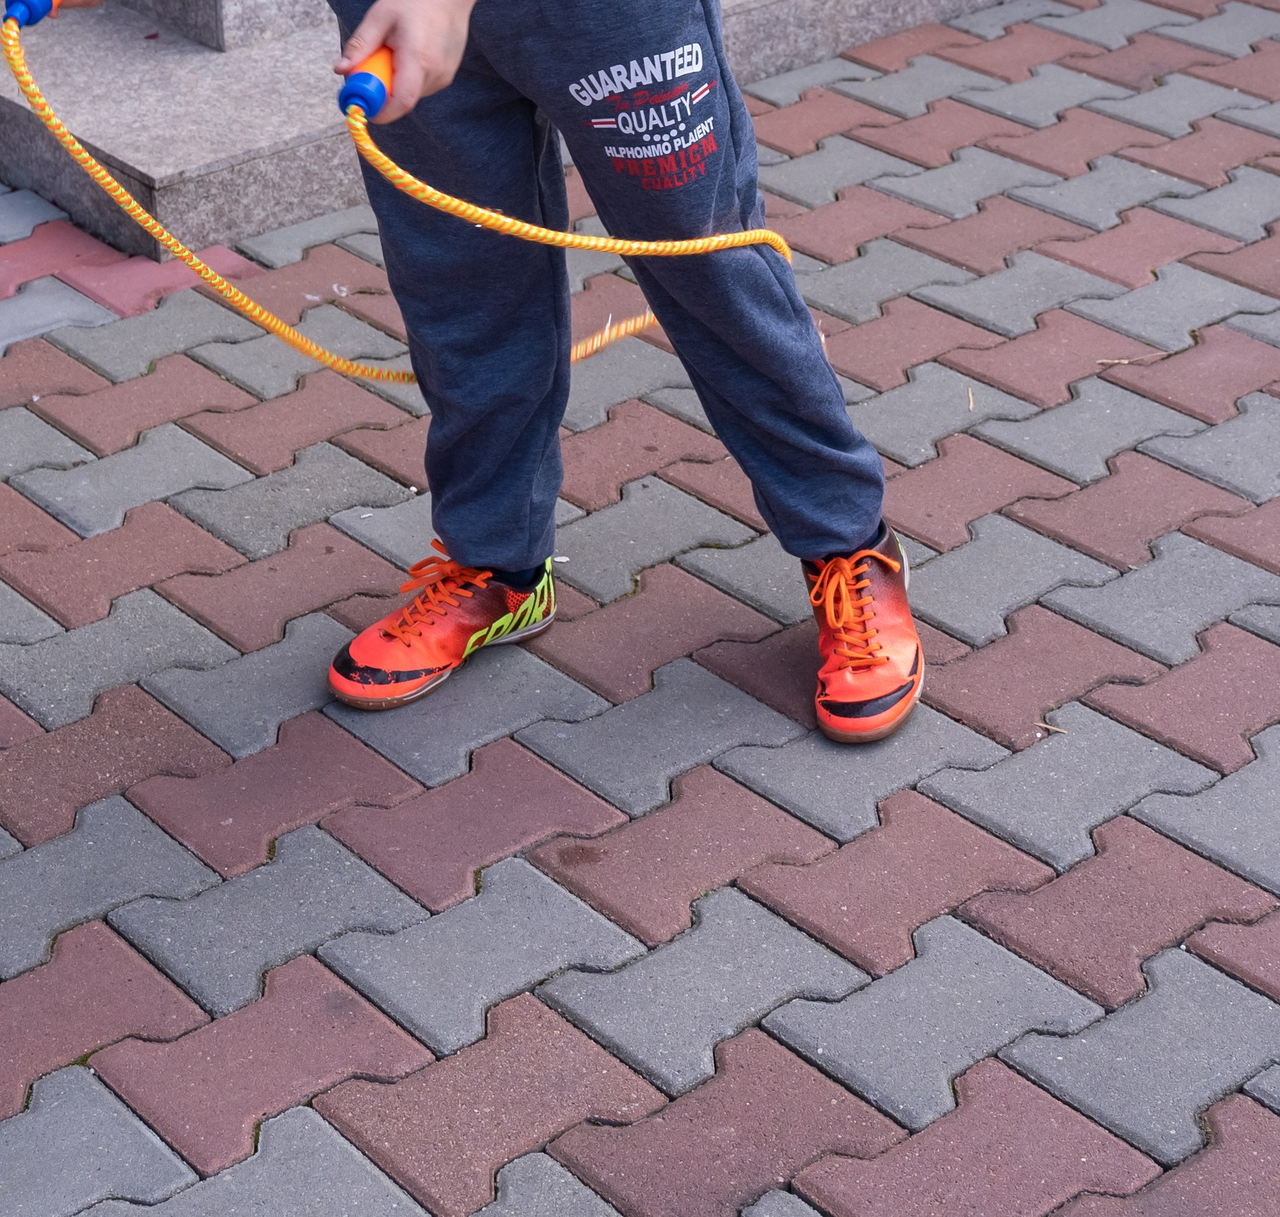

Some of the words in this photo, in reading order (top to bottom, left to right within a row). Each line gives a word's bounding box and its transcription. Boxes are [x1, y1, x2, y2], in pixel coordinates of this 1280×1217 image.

[569, 43, 703, 106] GUARANTEED
[617, 92, 692, 135] QUALTY
[673, 117, 714, 151] PLAIENT
